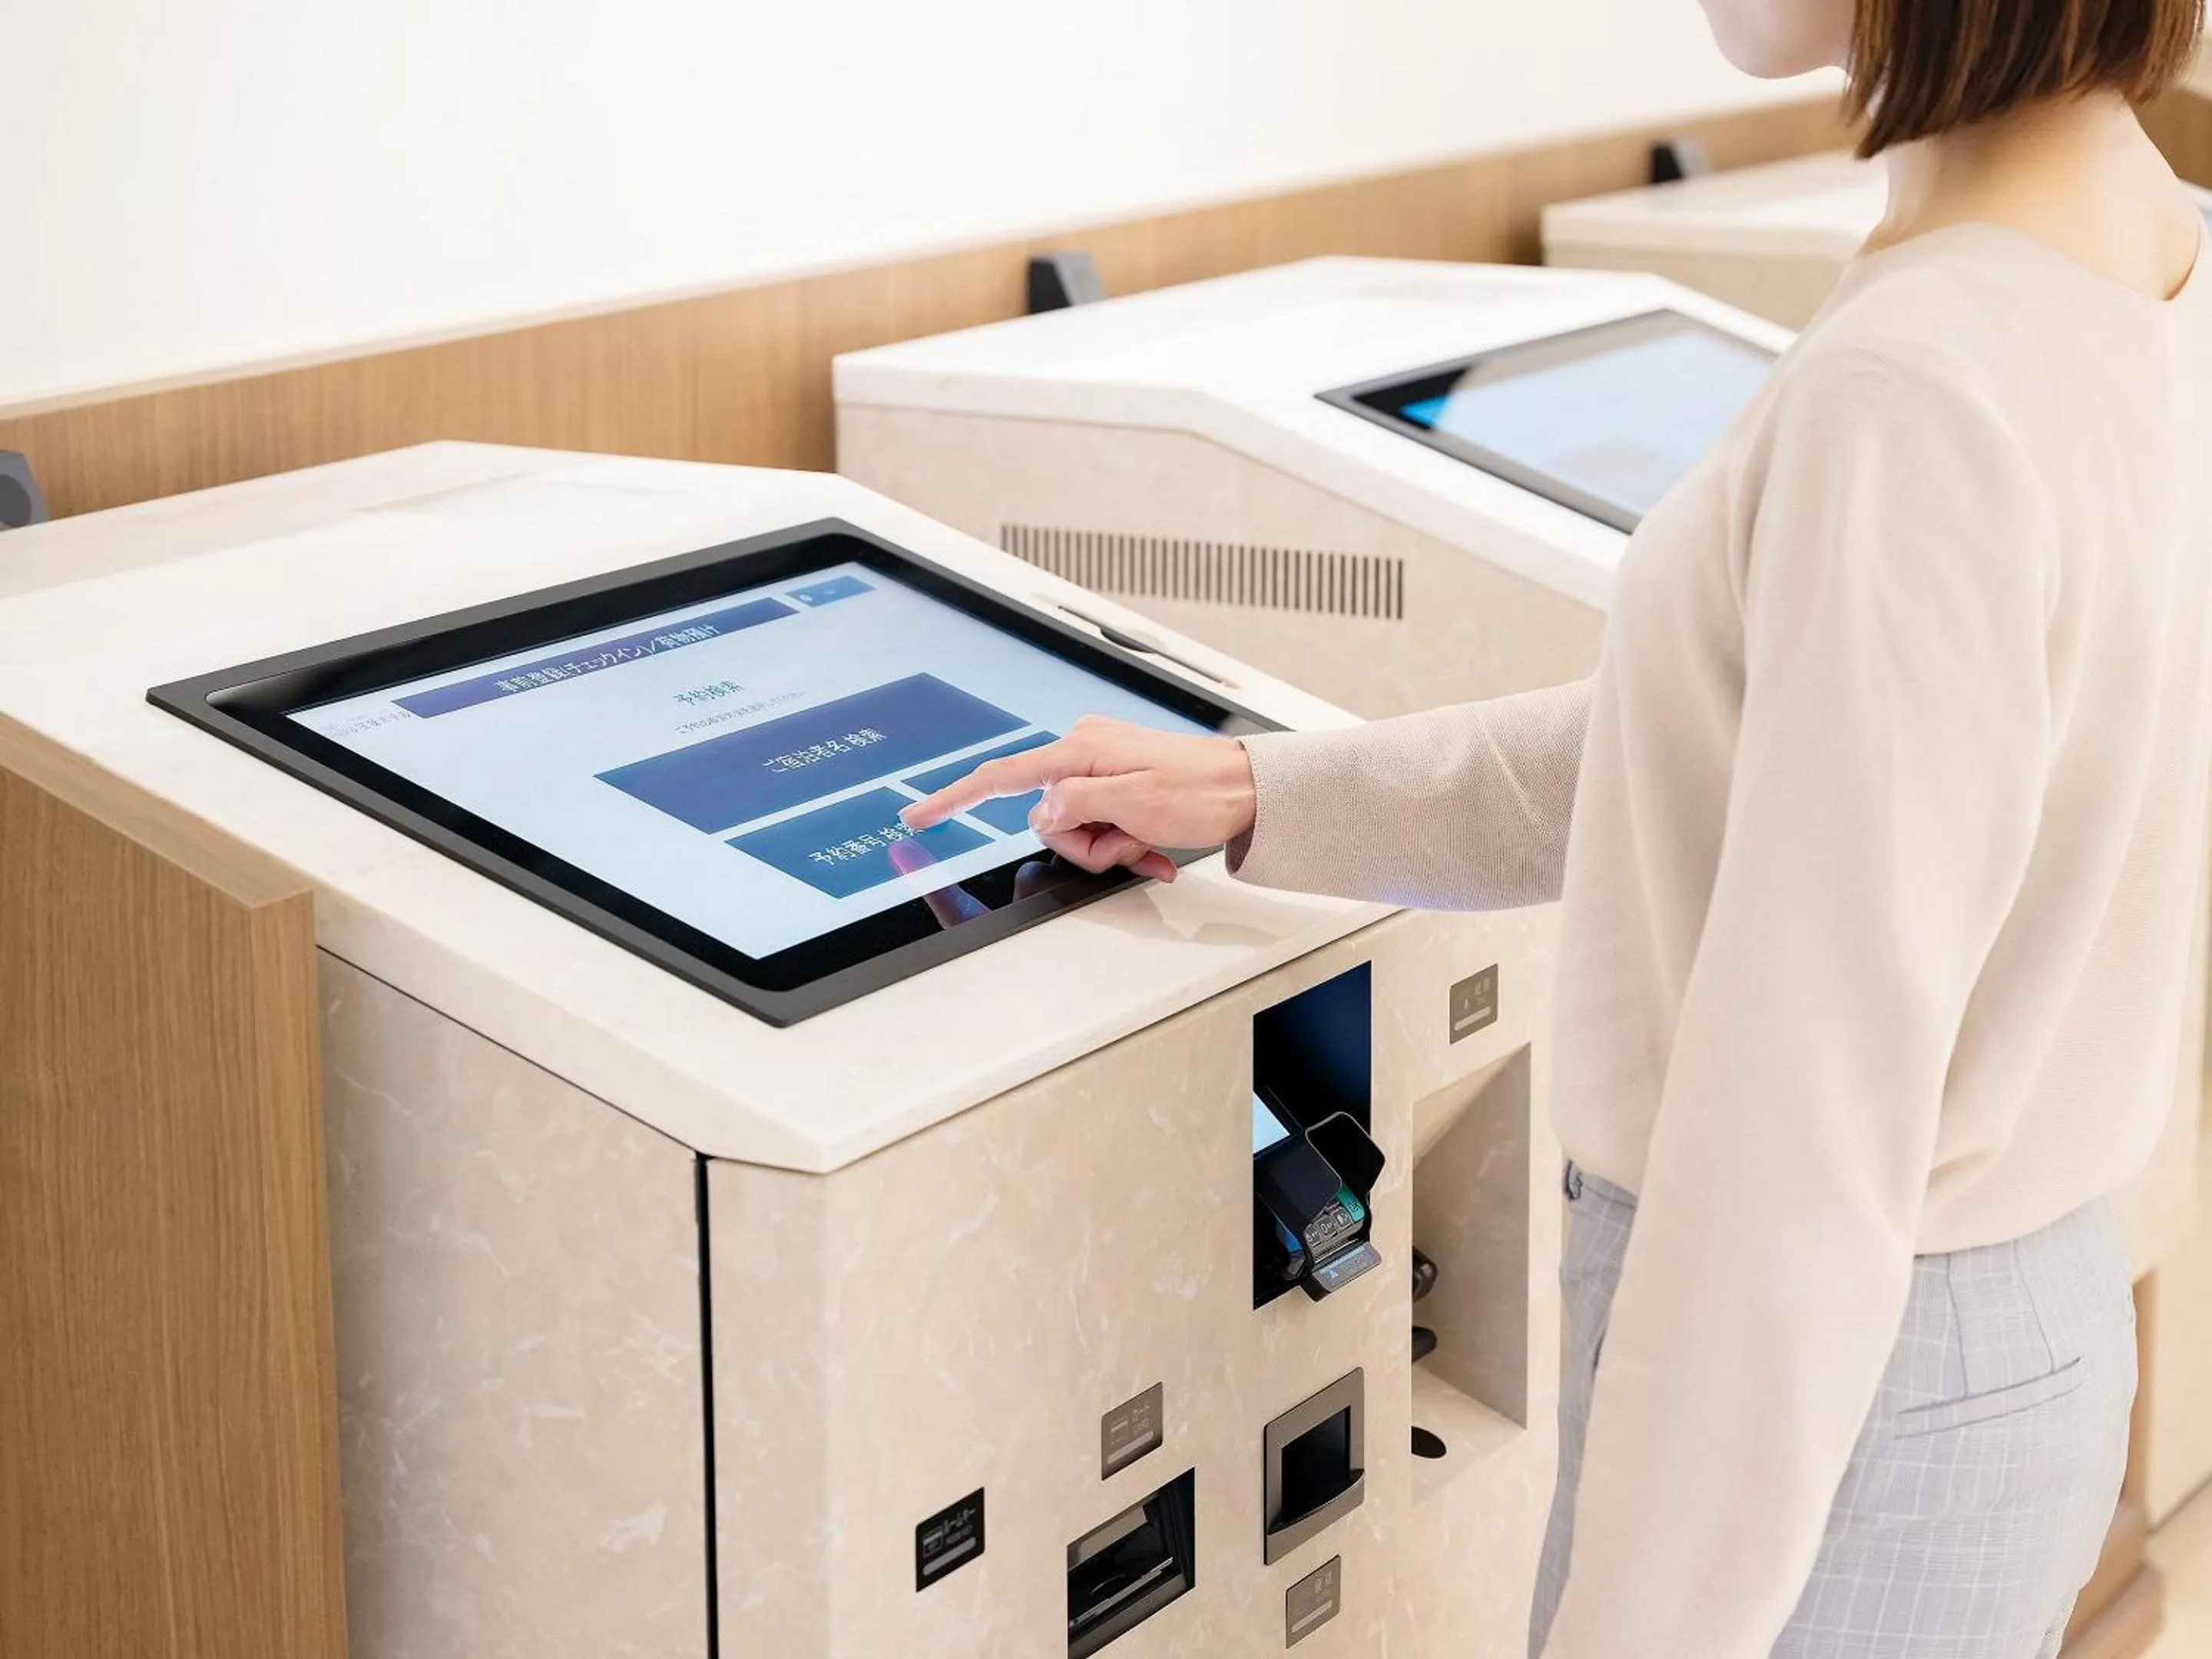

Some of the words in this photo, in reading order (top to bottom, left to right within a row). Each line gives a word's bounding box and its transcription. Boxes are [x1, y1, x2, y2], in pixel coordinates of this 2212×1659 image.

[762, 740, 853, 773] ご宿泊者名
[842, 727, 888, 747] 検索
[808, 834, 887, 866] 予約番号
